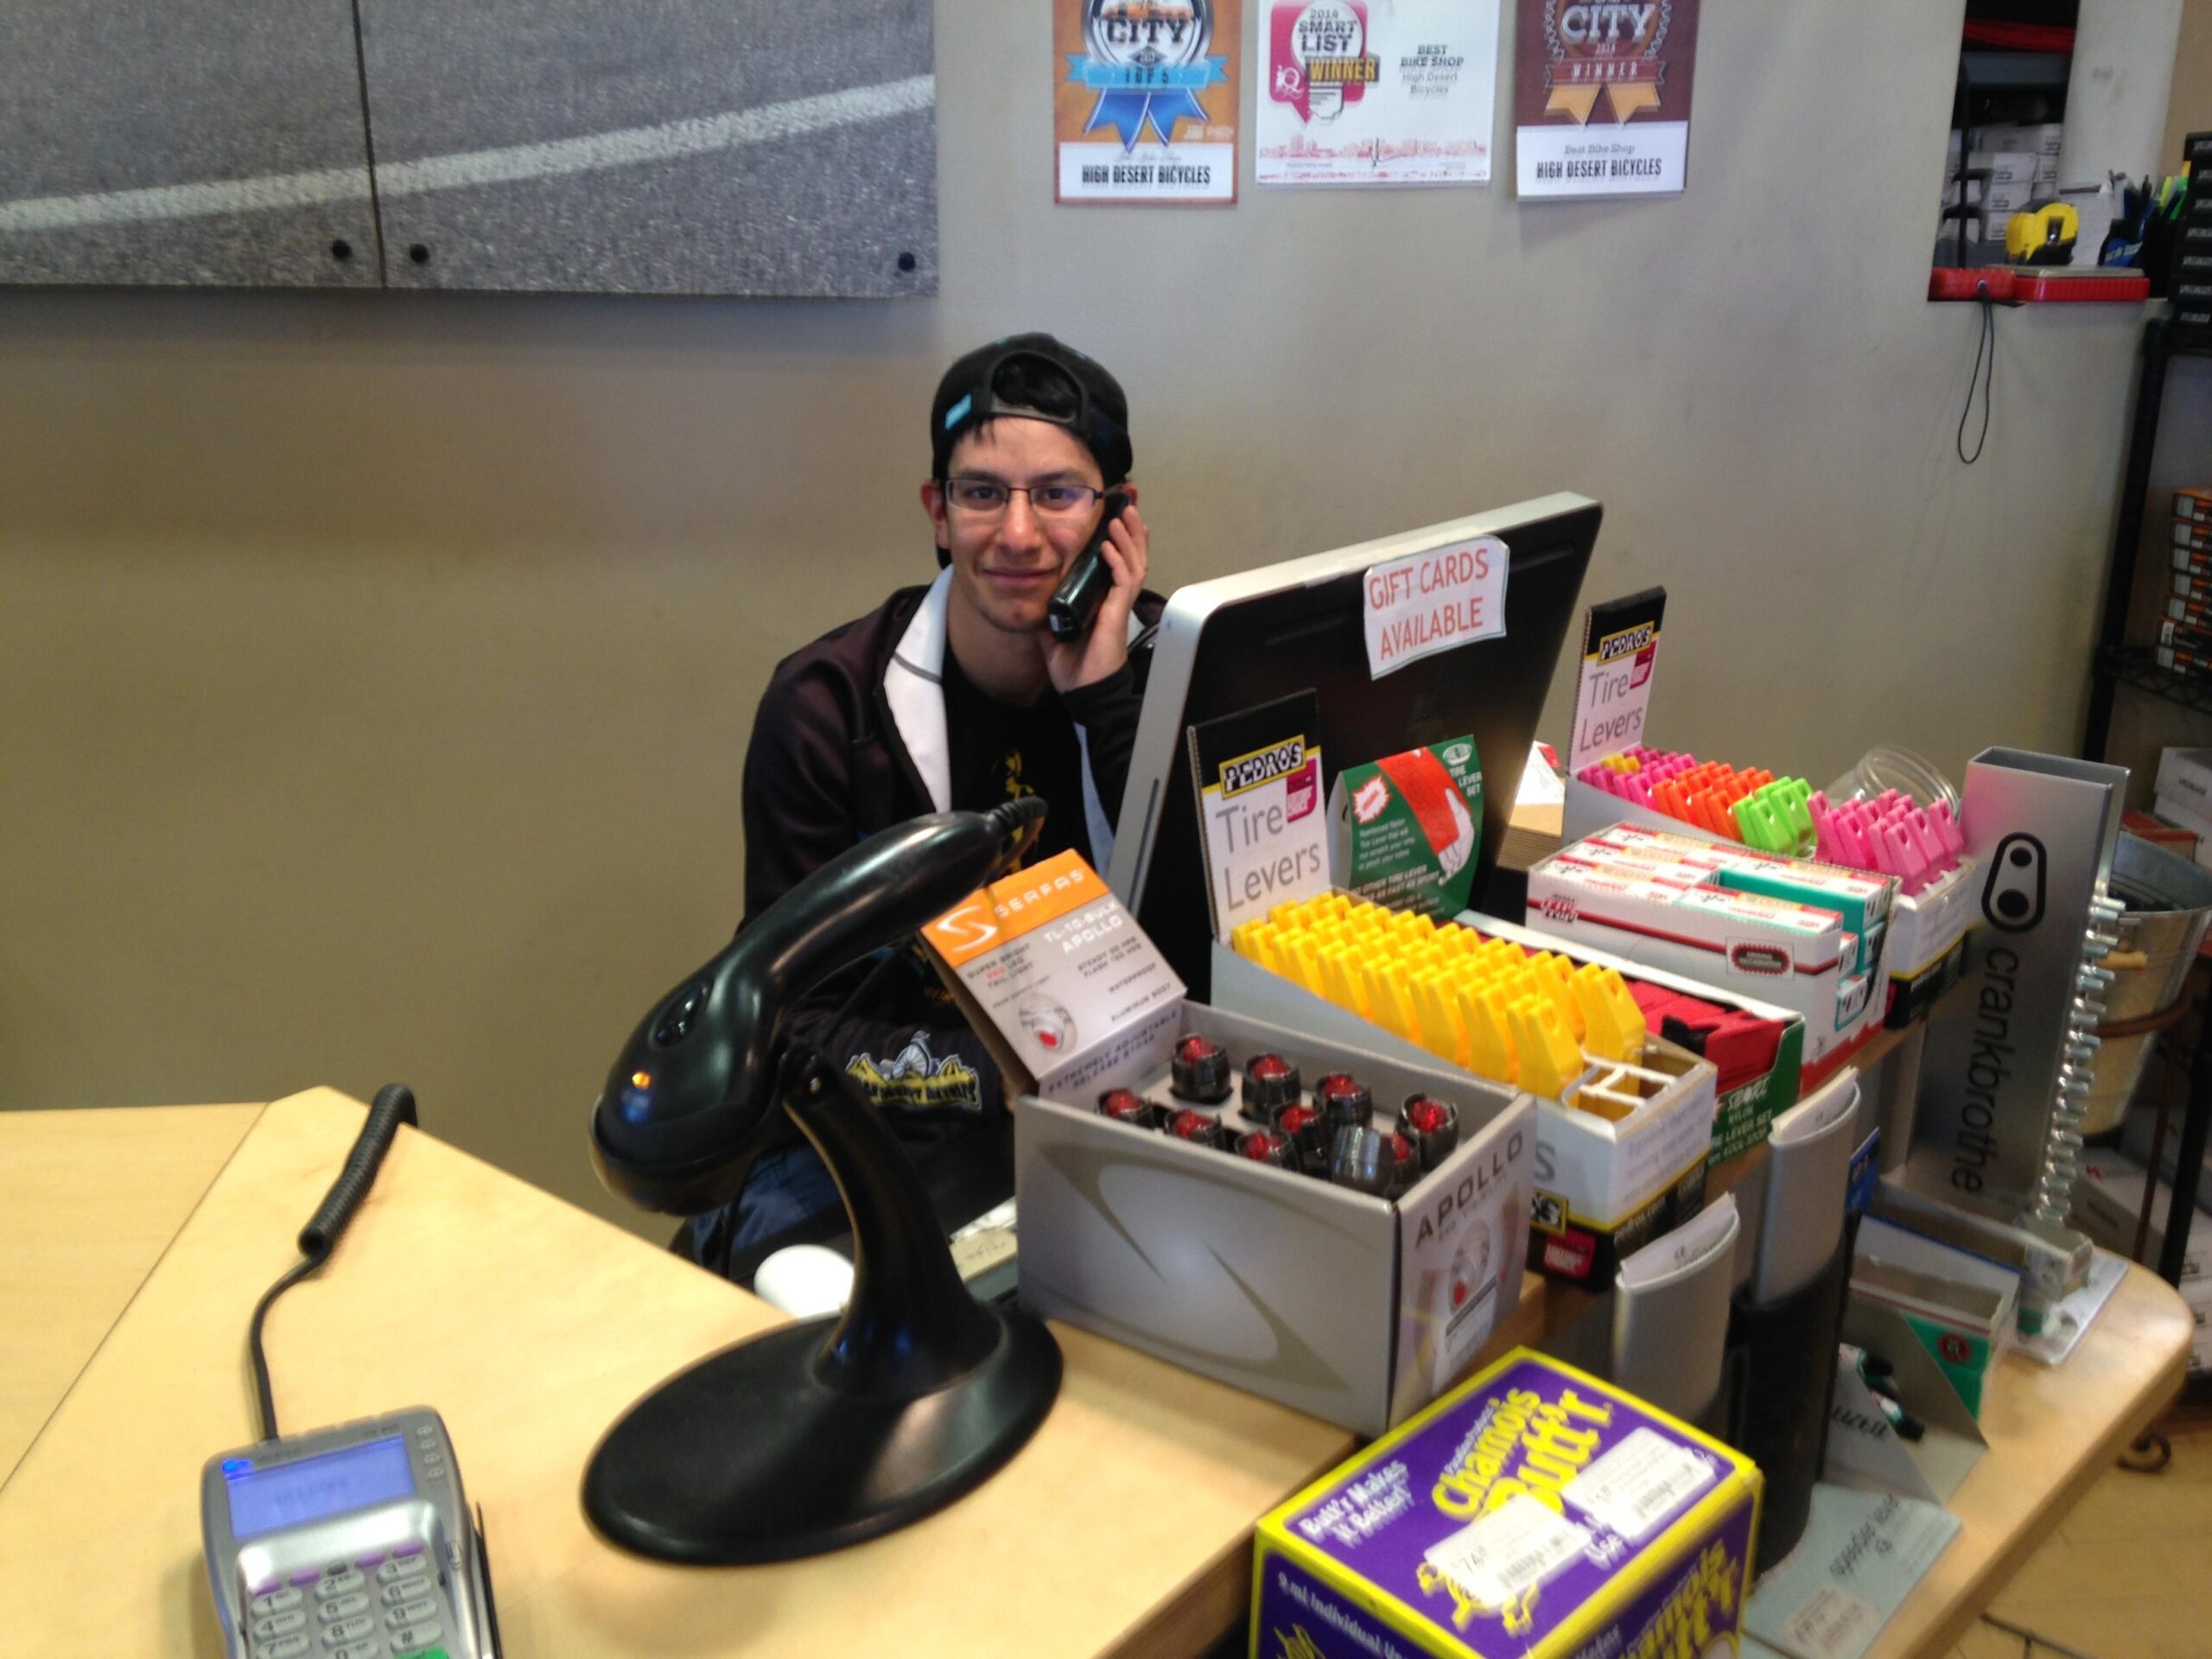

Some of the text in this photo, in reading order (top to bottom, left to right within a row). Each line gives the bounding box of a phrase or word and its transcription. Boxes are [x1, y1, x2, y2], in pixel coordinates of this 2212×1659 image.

[1299, 20, 1357, 33] SMART
[1560, 3, 1656, 40] CITY
[1301, 34, 1352, 52] LIST
[1400, 56, 1464, 67] BIKE SHOP
[1418, 44, 1448, 54] BEST
[1309, 58, 1376, 80] WINNER
[1573, 61, 1637, 78] WINNER
[1082, 165, 1211, 183] HIGH DESERT BICYCLES
[1537, 157, 1662, 178] HIGH DESERT BICYCLES
[1369, 548, 1489, 610] GIFT CARDS
[1381, 596, 1484, 660] AVAILABLE
[1589, 671, 1629, 708] Tire
[1580, 707, 1643, 752] Levers
[1215, 803, 1283, 854] Tire
[994, 869, 1084, 918] SERFAS
[1224, 843, 1321, 912] Levers
[1062, 914, 1123, 954] APOLLO
[1109, 962, 1156, 994] WATERPROOF
[1951, 947, 2019, 1193] crankbrothe
[1415, 1130, 1522, 1249] APOLLO
[1431, 1387, 1541, 1519] Chamois
[1346, 1459, 1409, 1507] Makes
[264, 1597, 273, 1607] 1
[325, 1579, 337, 1591] 2
[262, 1620, 274, 1634] 4
[1310, 1592, 1382, 1656] Individual
[266, 1643, 276, 1654] 7
